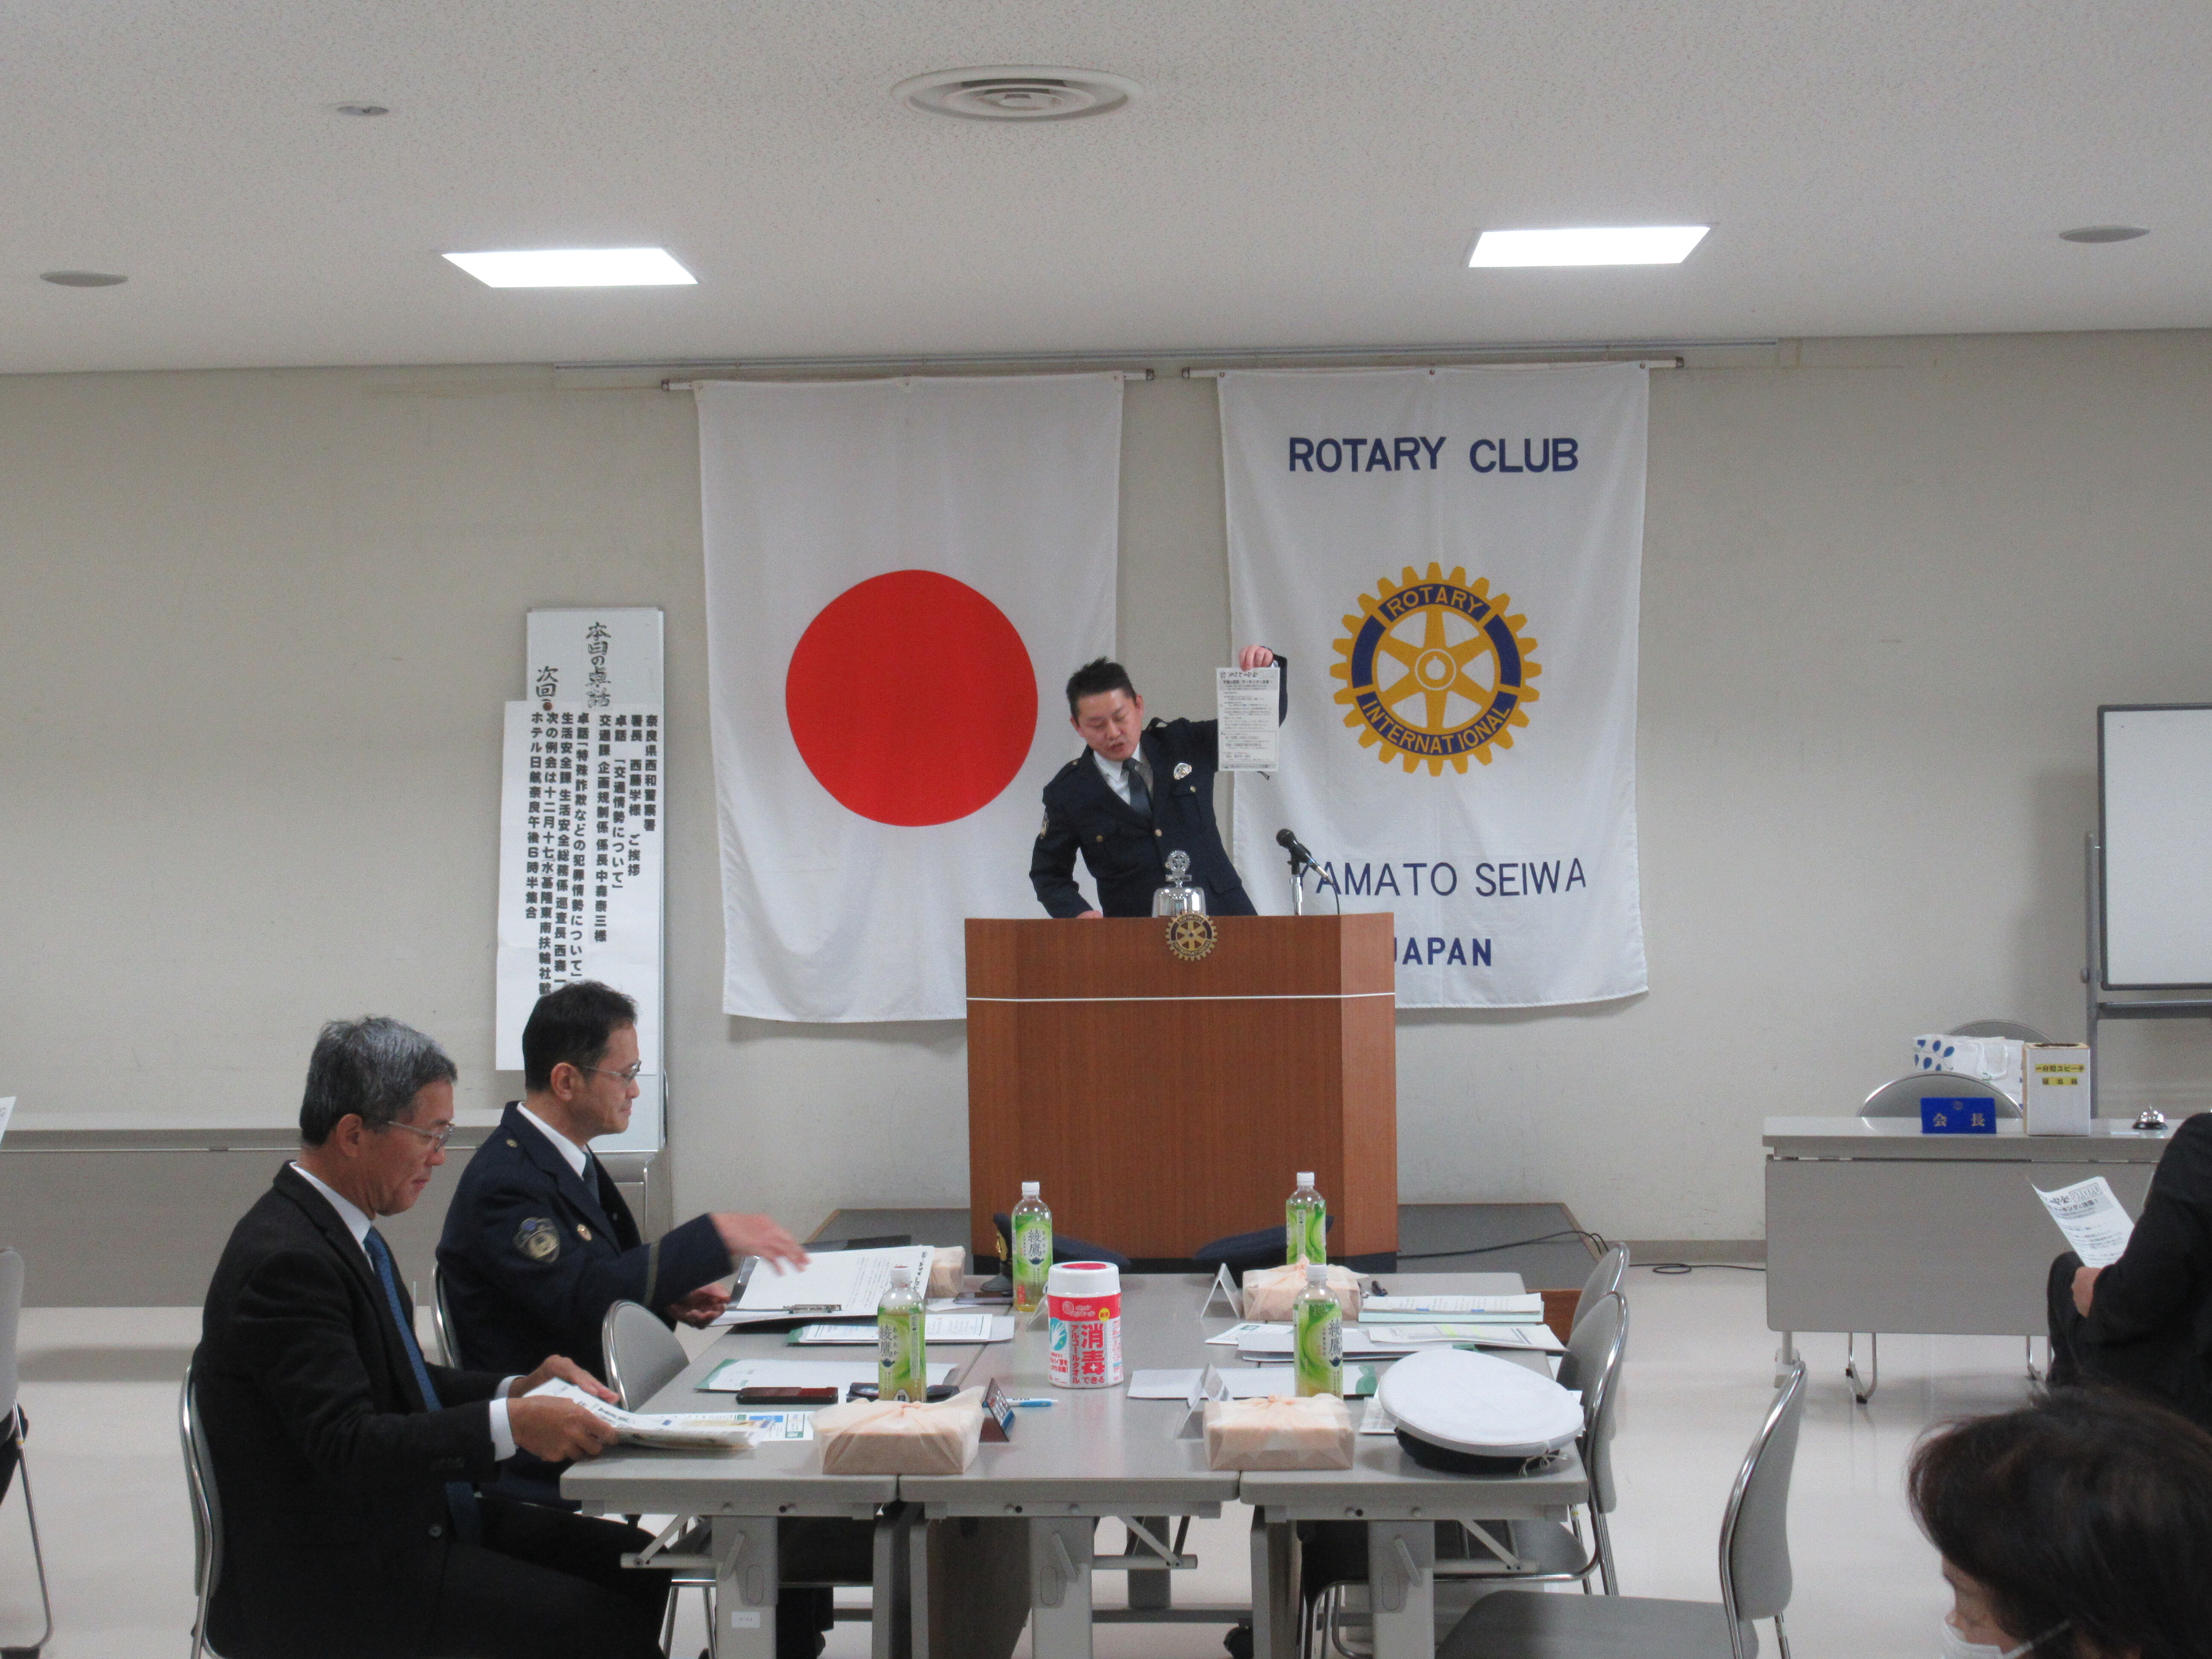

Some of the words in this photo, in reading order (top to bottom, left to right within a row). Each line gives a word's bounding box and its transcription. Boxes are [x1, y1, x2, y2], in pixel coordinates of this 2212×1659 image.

[1289, 437, 1447, 472] ROTARY
[1469, 438, 1579, 473] CLUB
[1386, 586, 1483, 617] ROTARY
[585, 621, 611, 709] 本日の卓話
[614, 714, 627, 742] 卓話
[1362, 700, 1511, 754] INTERNATIONAL
[644, 714, 658, 831] 奈良県西和警察署
[1475, 858, 1586, 896] SEIWA
[1932, 1112, 1985, 1127] 会長
[1028, 1228, 1042, 1257] 綾鷹
[1071, 1324, 1080, 1384] アルコールタオル
[1081, 1323, 1106, 1375] 消毒
[1082, 1376, 1106, 1384] できる
